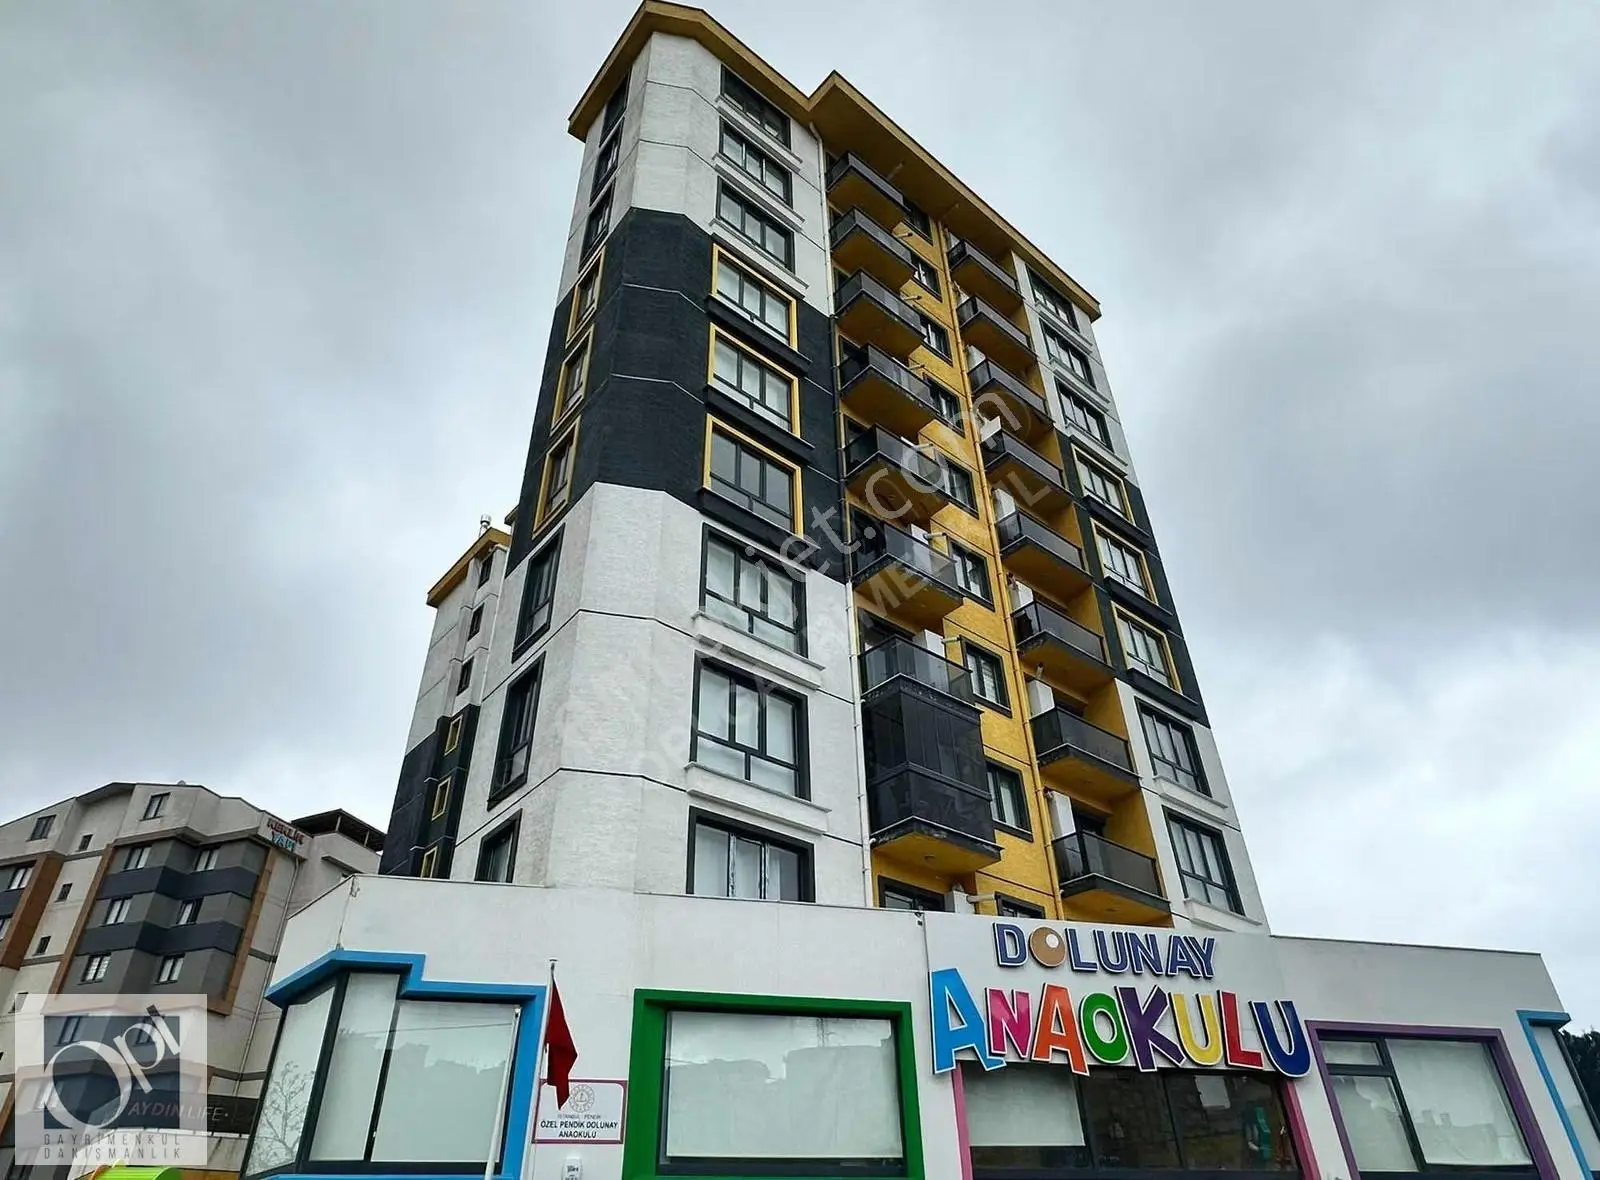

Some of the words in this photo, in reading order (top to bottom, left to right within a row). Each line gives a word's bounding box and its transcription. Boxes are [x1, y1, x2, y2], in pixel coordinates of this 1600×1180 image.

[993, 922, 1215, 978] DOLUNAY
[929, 967, 1312, 1079] ANAOKULU
[558, 1130, 597, 1139] ANAOKULU
[586, 1120, 618, 1129] DOLUNAY
